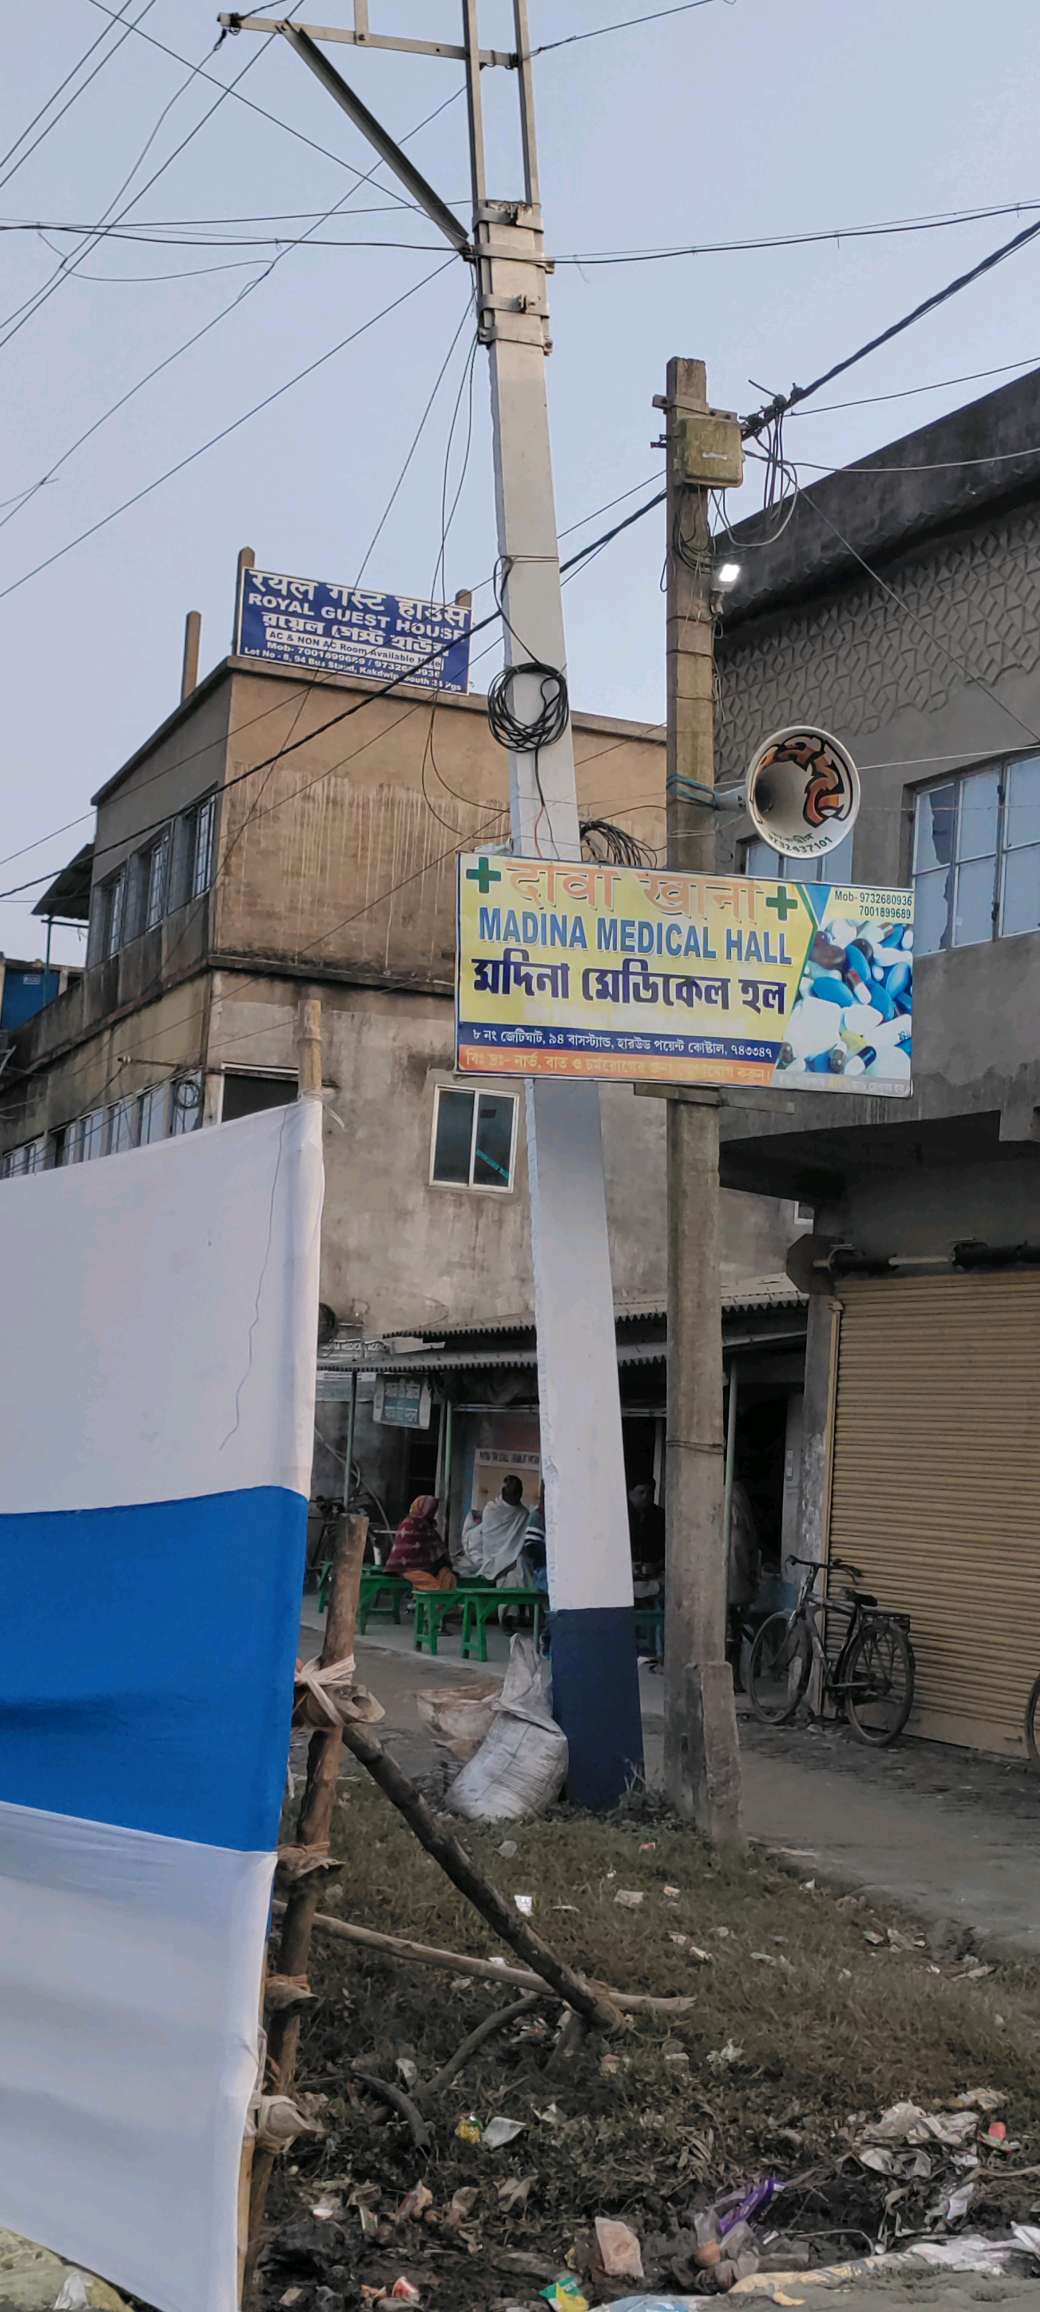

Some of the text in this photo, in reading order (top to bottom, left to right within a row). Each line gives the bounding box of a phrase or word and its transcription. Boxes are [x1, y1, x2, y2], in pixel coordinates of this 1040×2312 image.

[248, 593, 465, 643] ROYAL GUEST HOUSE
[268, 630, 280, 639] AC
[297, 635, 319, 646] NON
[323, 640, 336, 649] AC
[340, 643, 366, 654] Room
[370, 648, 414, 663] Available
[859, 905, 911, 919] 7001899689
[860, 892, 913, 906] 9732680936
[479, 906, 793, 965] MADINA MEDICAL HALL
[471, 947, 787, 1015] মদিনা মেডিকেল হল
